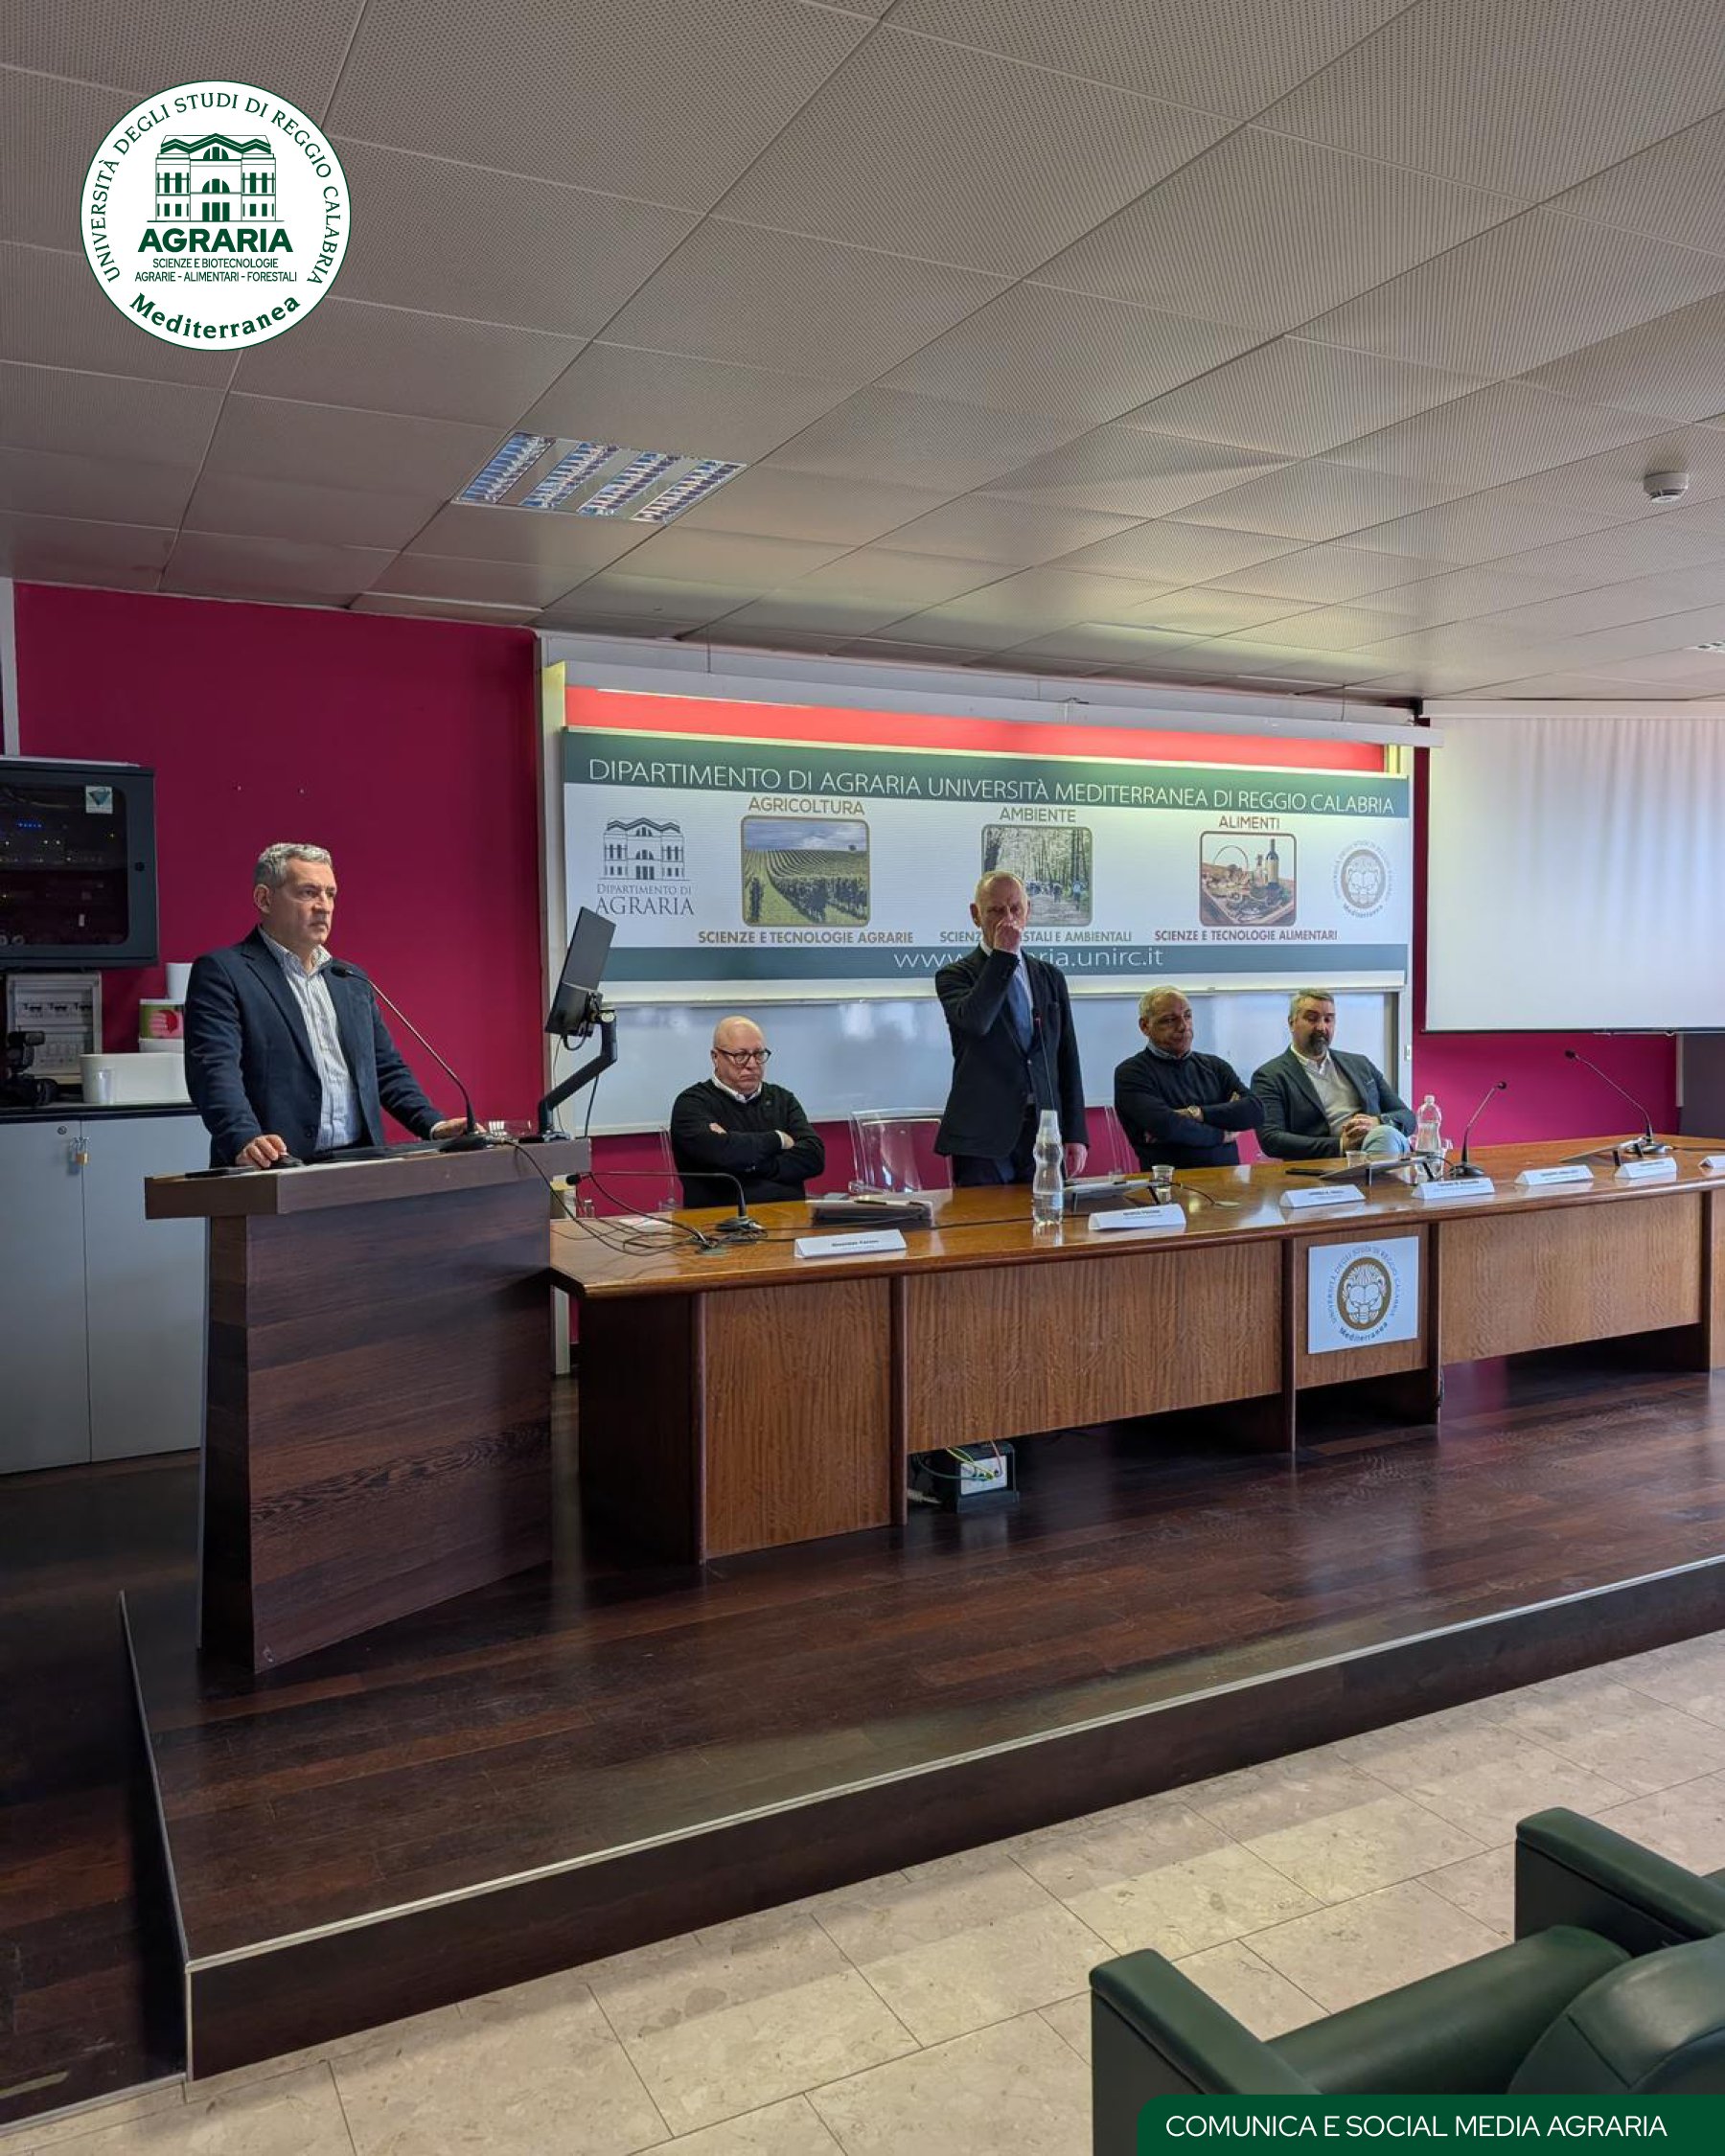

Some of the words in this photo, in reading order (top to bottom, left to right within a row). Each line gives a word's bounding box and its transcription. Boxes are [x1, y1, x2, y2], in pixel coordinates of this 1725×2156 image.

[589, 758, 781, 789] DIPARTIMENTO
[789, 769, 812, 791] DI
[820, 771, 921, 796] AGRARIA
[929, 776, 1049, 800] UNIVERSITÀ
[1055, 782, 1208, 807] MEDITERRANEA
[1214, 790, 1232, 808] DI
[1238, 791, 1306, 811] REGGIO
[1311, 794, 1394, 814] CALABRIA
[748, 796, 864, 816] AGRICOLTURA
[1000, 807, 1076, 823] AMBIENTE
[1219, 815, 1280, 830] ALIMENTI
[596, 896, 694, 915] AGRARIA
[699, 930, 756, 944] SCIENZE
[761, 931, 767, 944] E
[770, 931, 854, 945] TECNOLOGIE
[859, 931, 913, 944] AGRARIE
[939, 930, 981, 942] SCIENZ
[1056, 930, 1062, 942] E
[1065, 930, 1132, 942] AMBIENTALI
[1155, 930, 1199, 941] SCIENZE
[1202, 930, 1208, 941] E
[1210, 930, 1276, 941] TECNOLOGIE
[1279, 929, 1338, 941] ALIMENTARI
